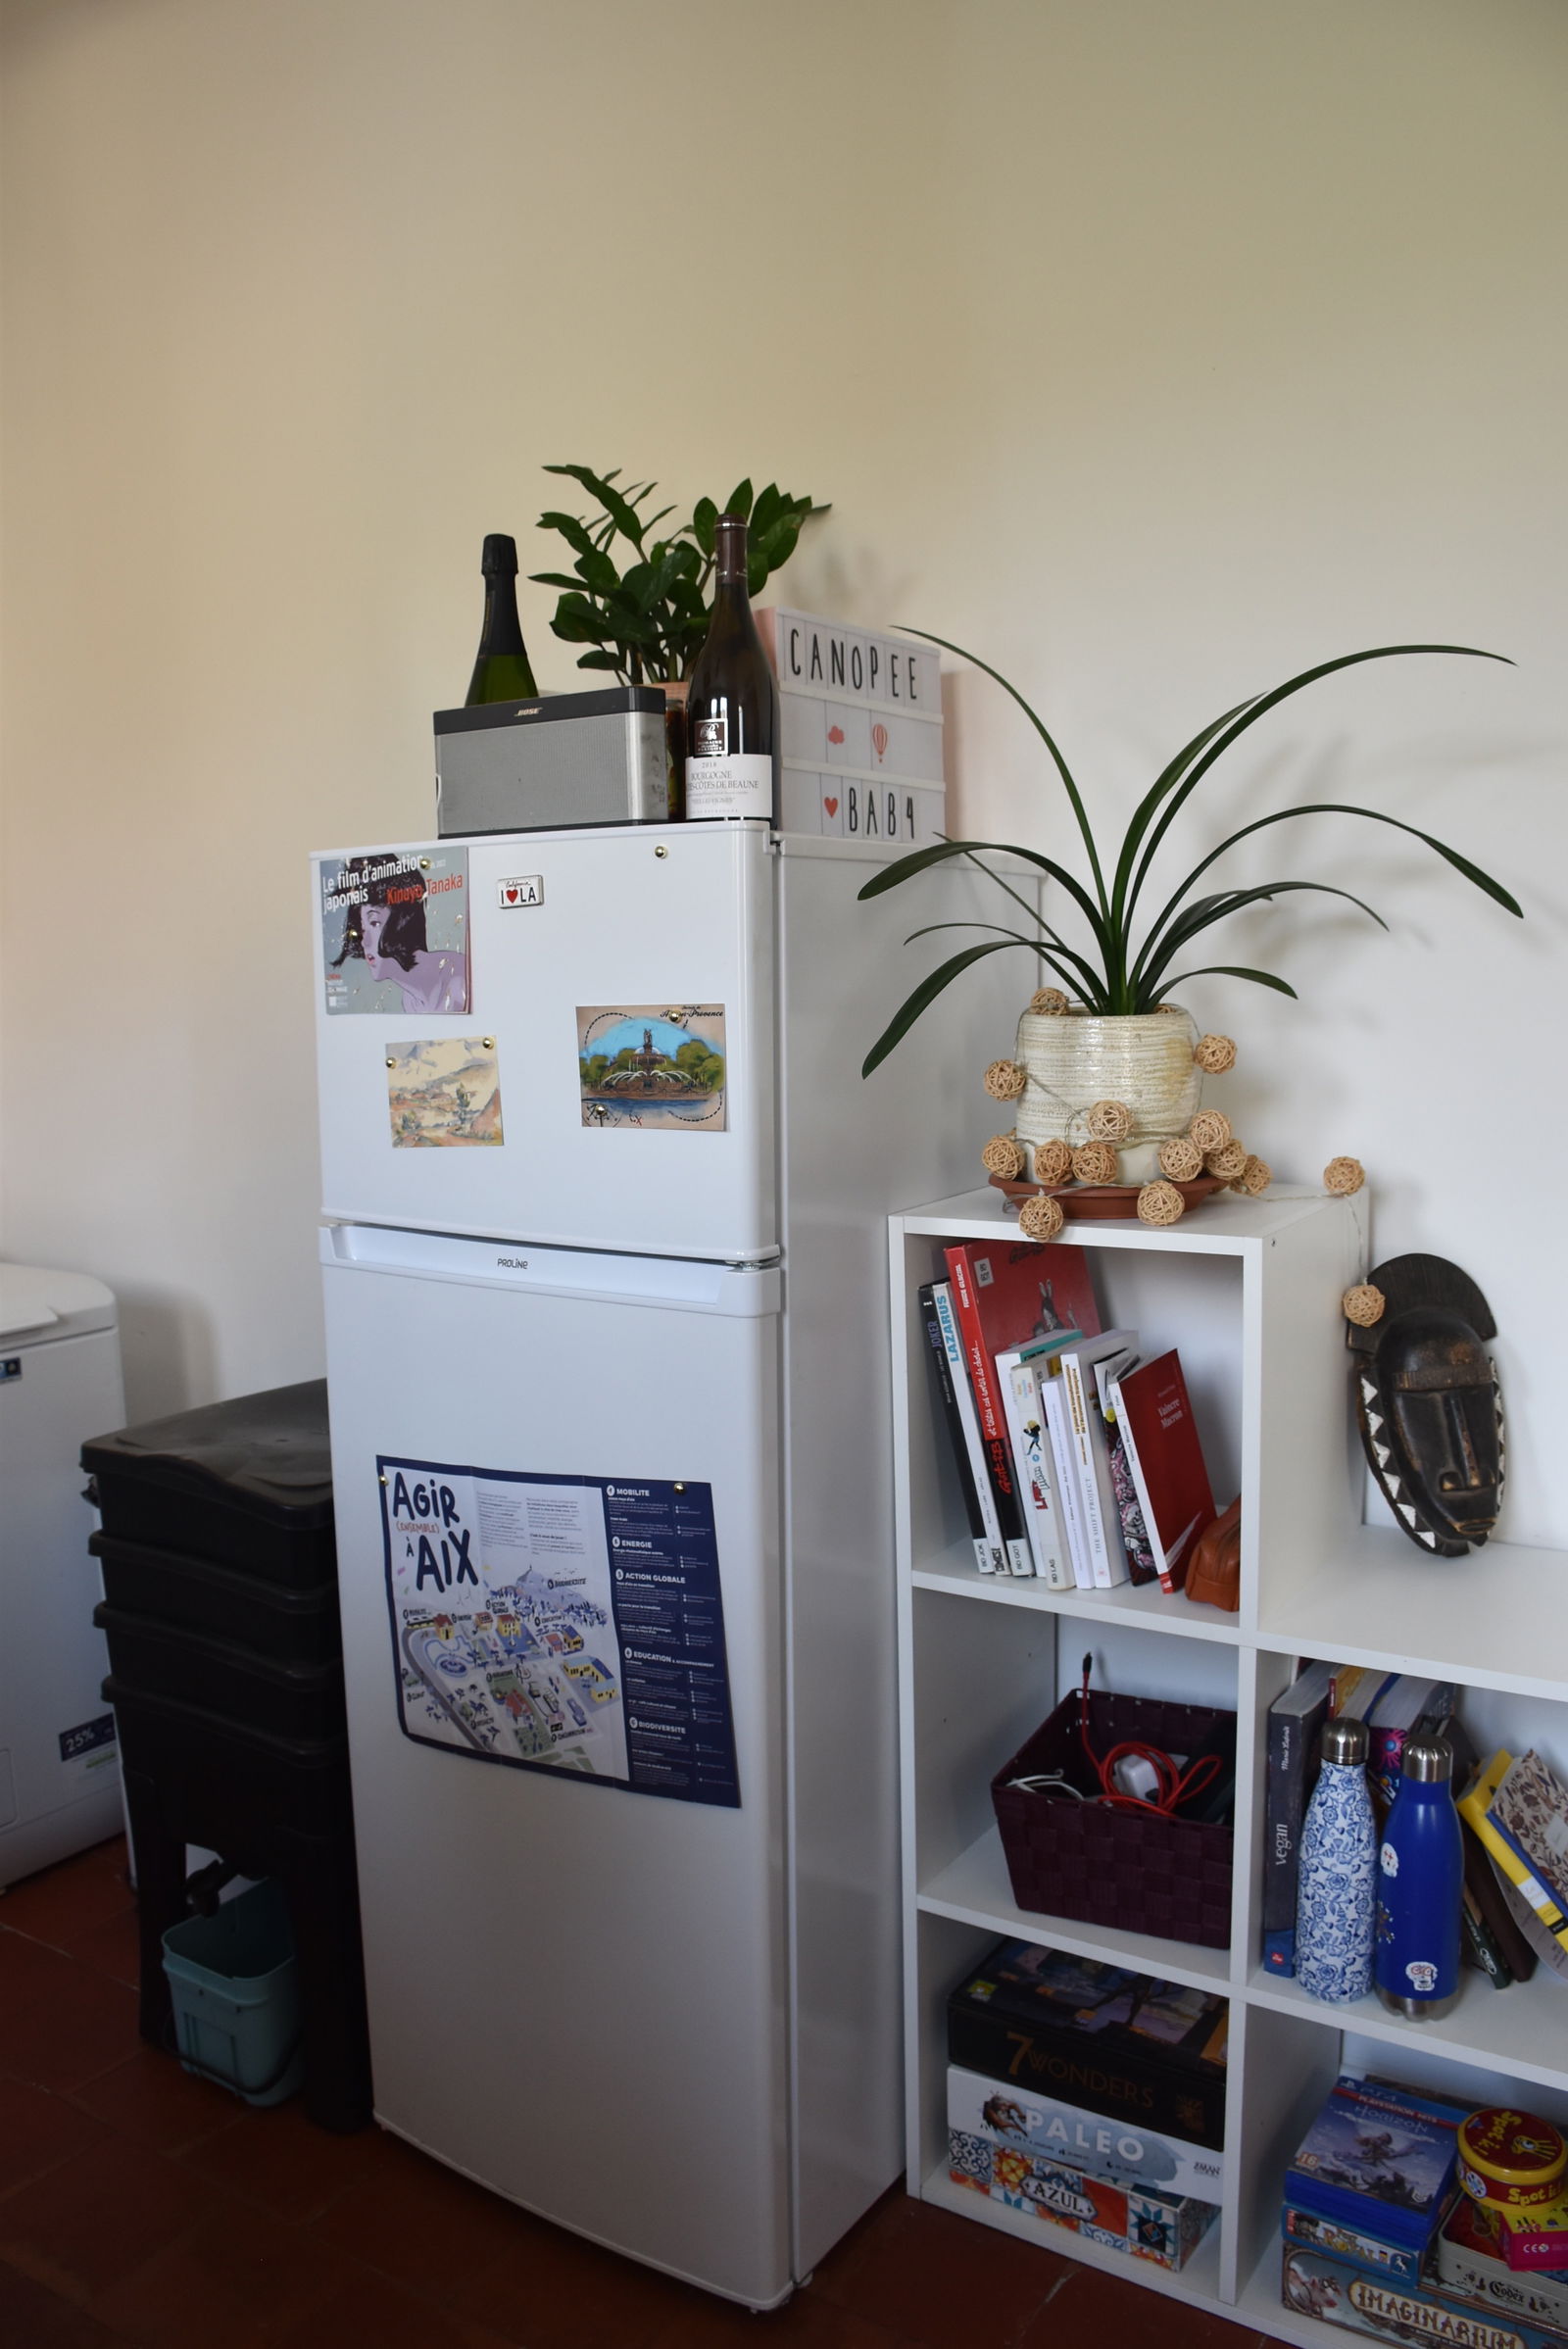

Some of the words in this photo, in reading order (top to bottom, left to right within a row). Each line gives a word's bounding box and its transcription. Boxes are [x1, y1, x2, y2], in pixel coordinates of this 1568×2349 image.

[790, 628, 917, 700] CANOPEE
[515, 707, 542, 717] BOSE
[322, 876, 334, 893] Le
[337, 869, 360, 890] film
[362, 855, 423, 884] d'animation
[323, 886, 368, 915] japonais
[386, 885, 423, 905] Kinuyo
[425, 873, 464, 896] Tanaka
[520, 887, 536, 903] LA
[927, 1320, 943, 1348] JOKER
[936, 1295, 959, 1362] LAZARUS
[616, 1488, 650, 1496] MOBILITE
[1084, 1477, 1096, 1512] PROJECT
[1090, 1513, 1101, 1537] SHIFT
[621, 1540, 653, 1548] ENERGIE
[977, 1542, 986, 1557] JOK
[1011, 1543, 1021, 1559] GOT
[1094, 1538, 1102, 1554] THE
[416, 1529, 479, 1593] AIX
[1048, 1558, 1057, 1573] LAS
[625, 1572, 652, 1581] ACTION
[653, 1575, 686, 1584] GLOBALE
[633, 1650, 671, 1663] EDUCATION
[638, 1721, 686, 1735] BIODIVERSITE
[66, 1728, 95, 1753] 25%
[1005, 2031, 1034, 2076] 7
[1032, 2053, 1153, 2108] WONDERS
[1357, 2095, 1414, 2116] PLAYSTATION
[1025, 2108, 1145, 2162] PALEO
[1488, 2111, 1522, 2140] Spot
[1034, 2182, 1083, 2213] AZUL
[1507, 2187, 1545, 2207] Spot
[1490, 2280, 1524, 2304] Codex
[1358, 2281, 1517, 2349] IMAGINARIUM
